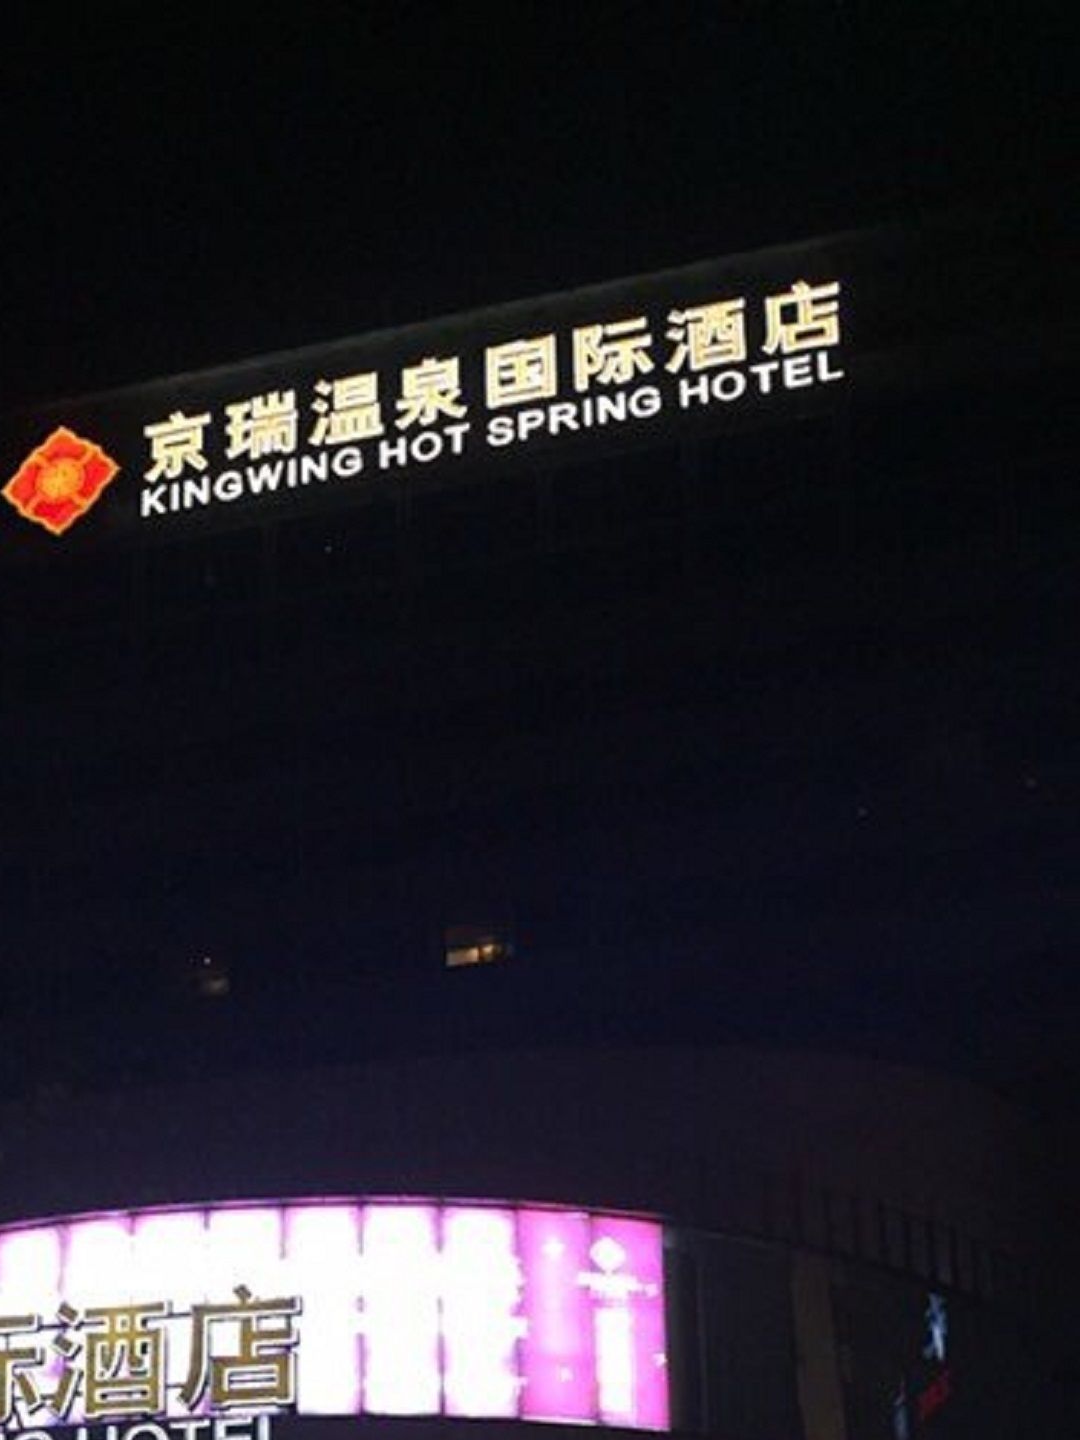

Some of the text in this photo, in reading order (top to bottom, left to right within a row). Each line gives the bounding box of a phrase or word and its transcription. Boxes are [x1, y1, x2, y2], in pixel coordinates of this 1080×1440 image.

[140, 350, 845, 517] KINGWING HOT SPRING HOTEL
[143, 280, 840, 482] 京瑞温泉国际酒店
